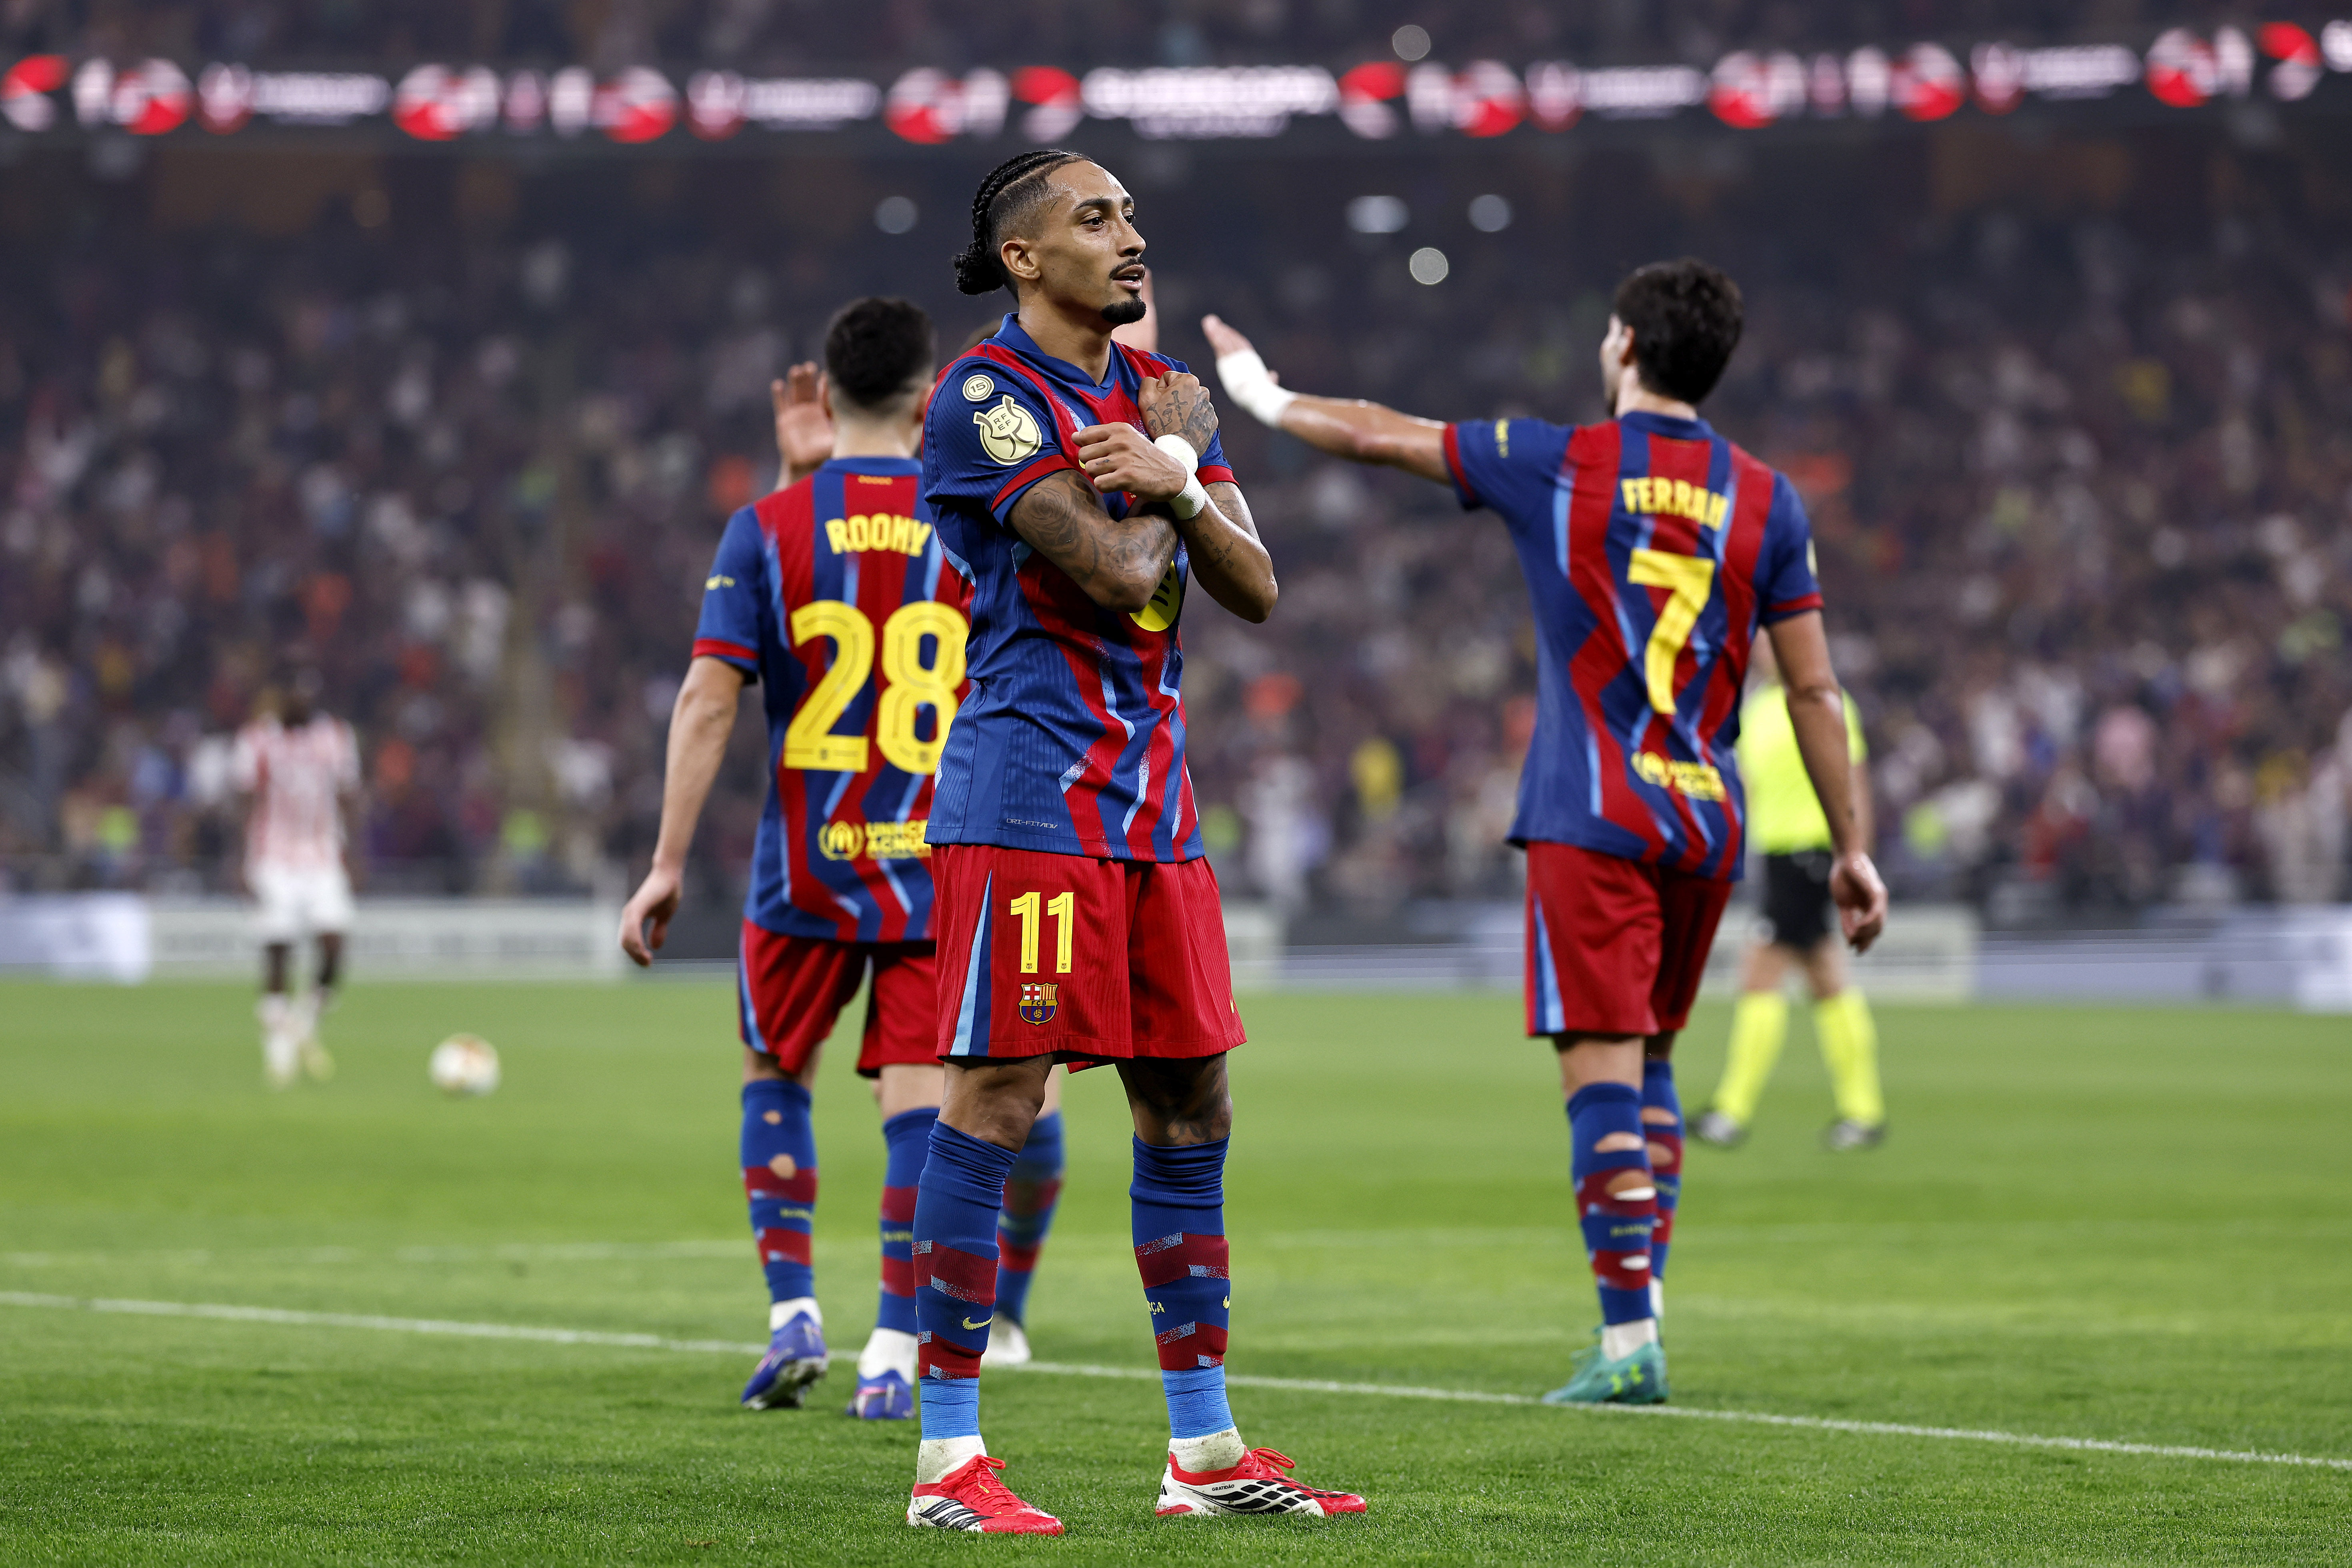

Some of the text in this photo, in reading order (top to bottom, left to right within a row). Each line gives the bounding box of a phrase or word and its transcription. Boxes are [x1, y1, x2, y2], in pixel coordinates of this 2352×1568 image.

[970, 382, 986, 392] 15
[825, 512, 932, 557] ROONY
[1621, 476, 1729, 532] FERRAN
[1627, 547, 1716, 715] 7
[783, 599, 970, 775] 28
[1010, 892, 1074, 973] 11
